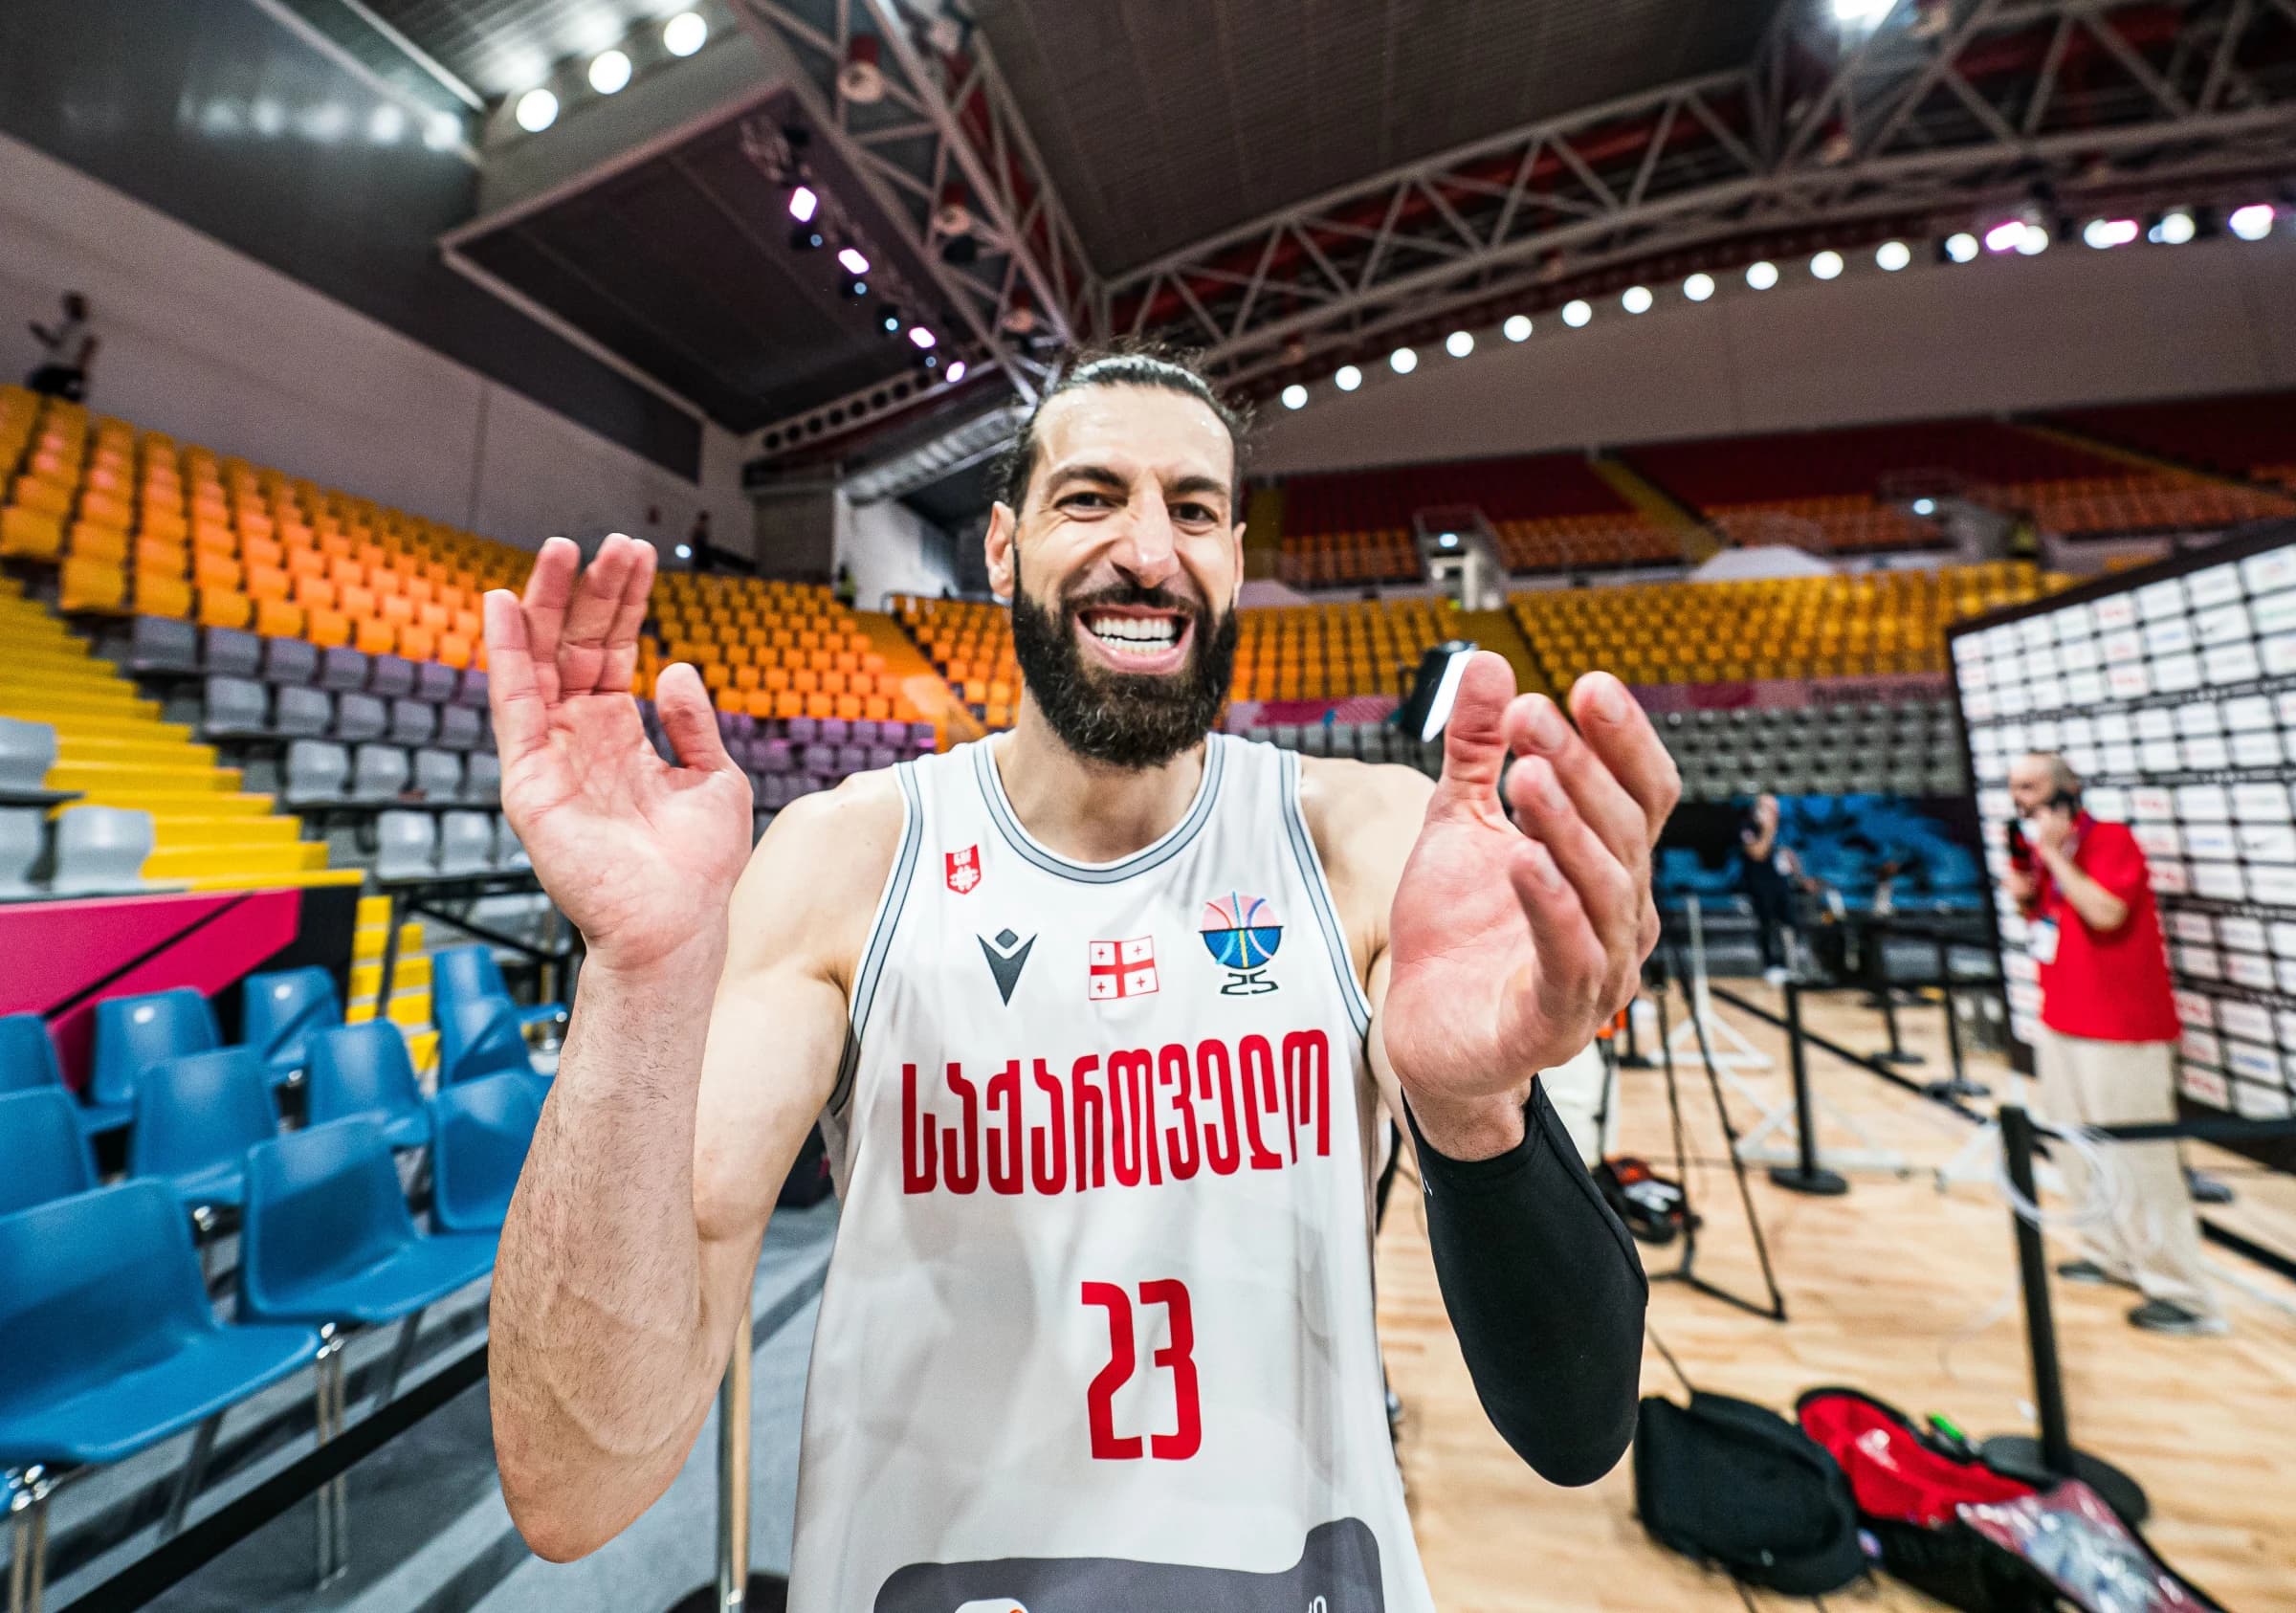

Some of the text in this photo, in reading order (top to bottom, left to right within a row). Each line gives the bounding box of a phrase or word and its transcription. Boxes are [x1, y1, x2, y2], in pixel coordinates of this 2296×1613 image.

[1221, 969, 1279, 995] 25
[902, 1028, 1331, 1196] საქართველო
[1081, 1278, 1203, 1461] 23
